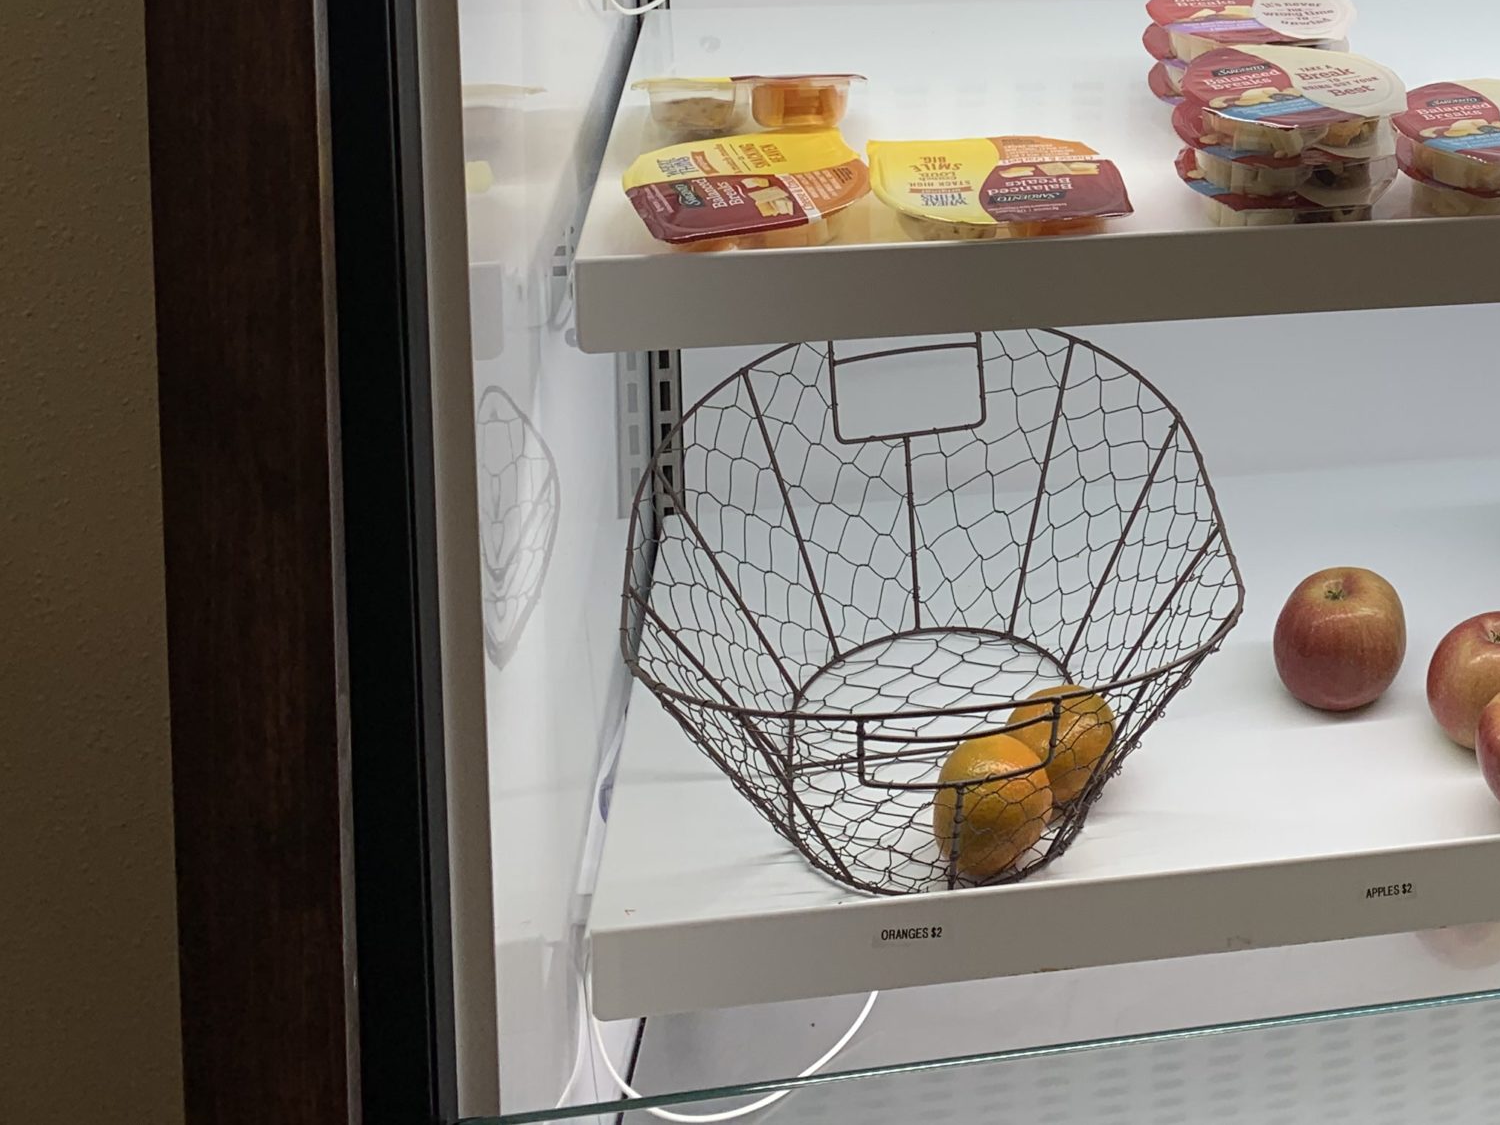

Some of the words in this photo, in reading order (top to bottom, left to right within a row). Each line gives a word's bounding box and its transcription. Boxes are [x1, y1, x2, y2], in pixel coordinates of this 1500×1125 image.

[1218, 65, 1266, 76] SARGENTO
[1296, 68, 1355, 81] Break
[1203, 69, 1280, 86] Balanced
[1211, 77, 1272, 90] Breaks
[1328, 85, 1375, 97] Best
[1432, 97, 1478, 106] SARGENTO
[1416, 102, 1492, 115] Balanced
[1423, 110, 1482, 121] Breaks
[739, 144, 769, 168] SNACKING
[760, 144, 787, 163] HEAVEN
[909, 163, 962, 172] SMILE
[1005, 177, 1071, 186] Breaks
[692, 178, 727, 209] Balanced
[717, 182, 744, 206] Breaks
[987, 183, 1073, 196] Balanced
[997, 192, 1062, 202] SARGENTO
[1366, 885, 1399, 898] APPLES
[1402, 883, 1412, 894] $2
[881, 927, 928, 940] ORANGES
[931, 927, 942, 938] $2
